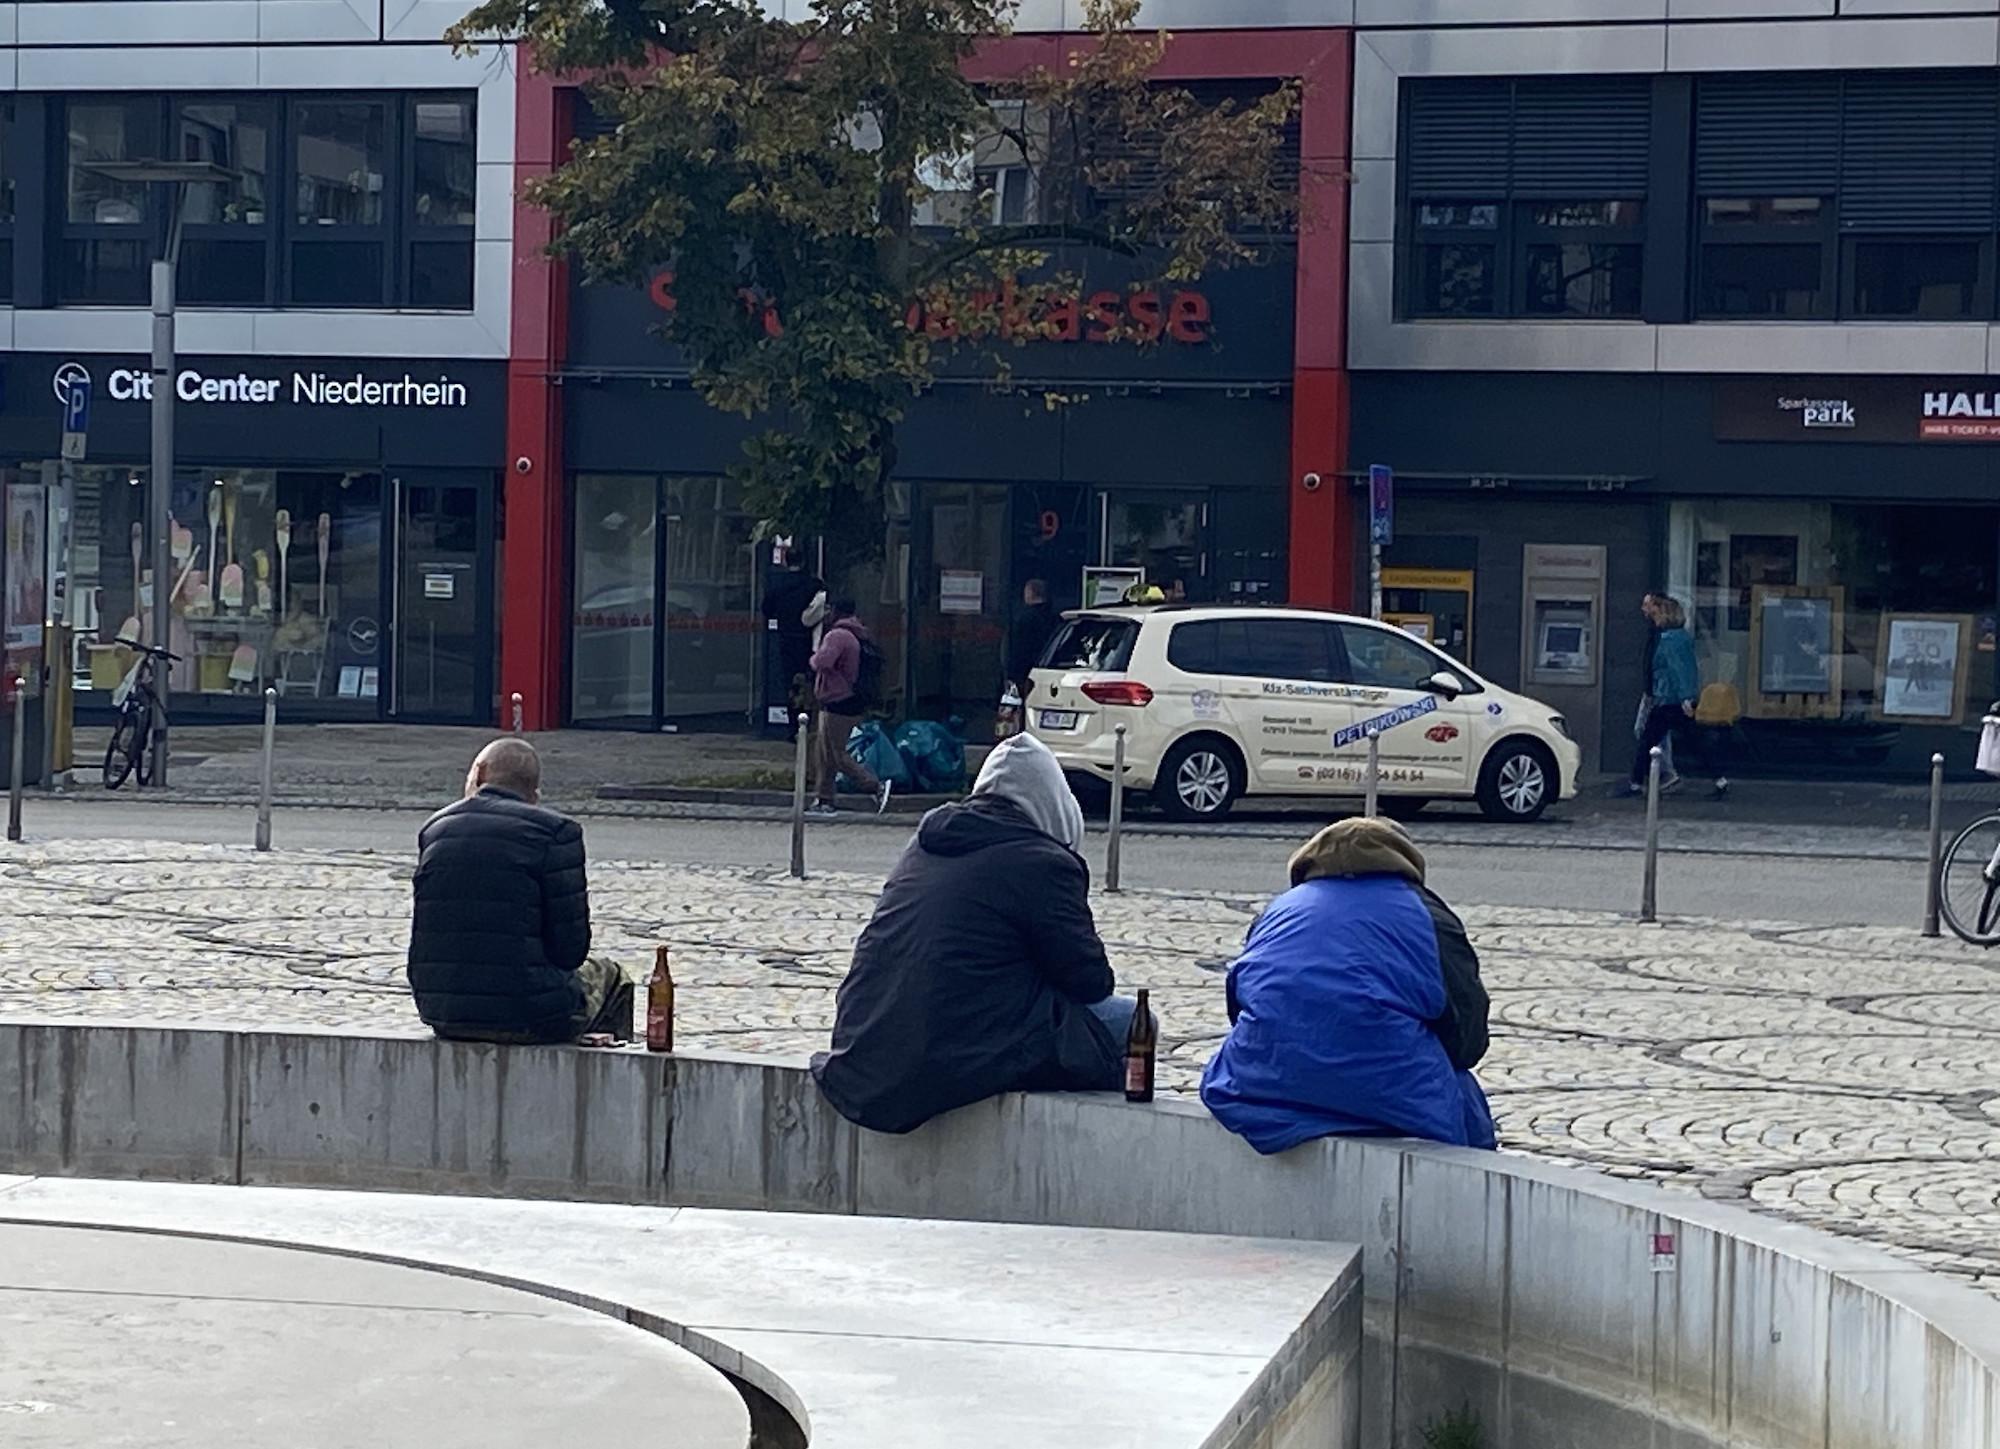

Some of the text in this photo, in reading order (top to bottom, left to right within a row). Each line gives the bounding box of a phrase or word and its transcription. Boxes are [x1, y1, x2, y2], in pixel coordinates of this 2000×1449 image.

[107, 369, 467, 407] Cit Center Niederrhein
[1777, 396, 1842, 410] Sparkassen
[70, 389, 85, 429] P
[1804, 400, 1855, 427] park
[1040, 510, 1060, 541] 9
[1336, 697, 1436, 746] PETRIKOWSKI
